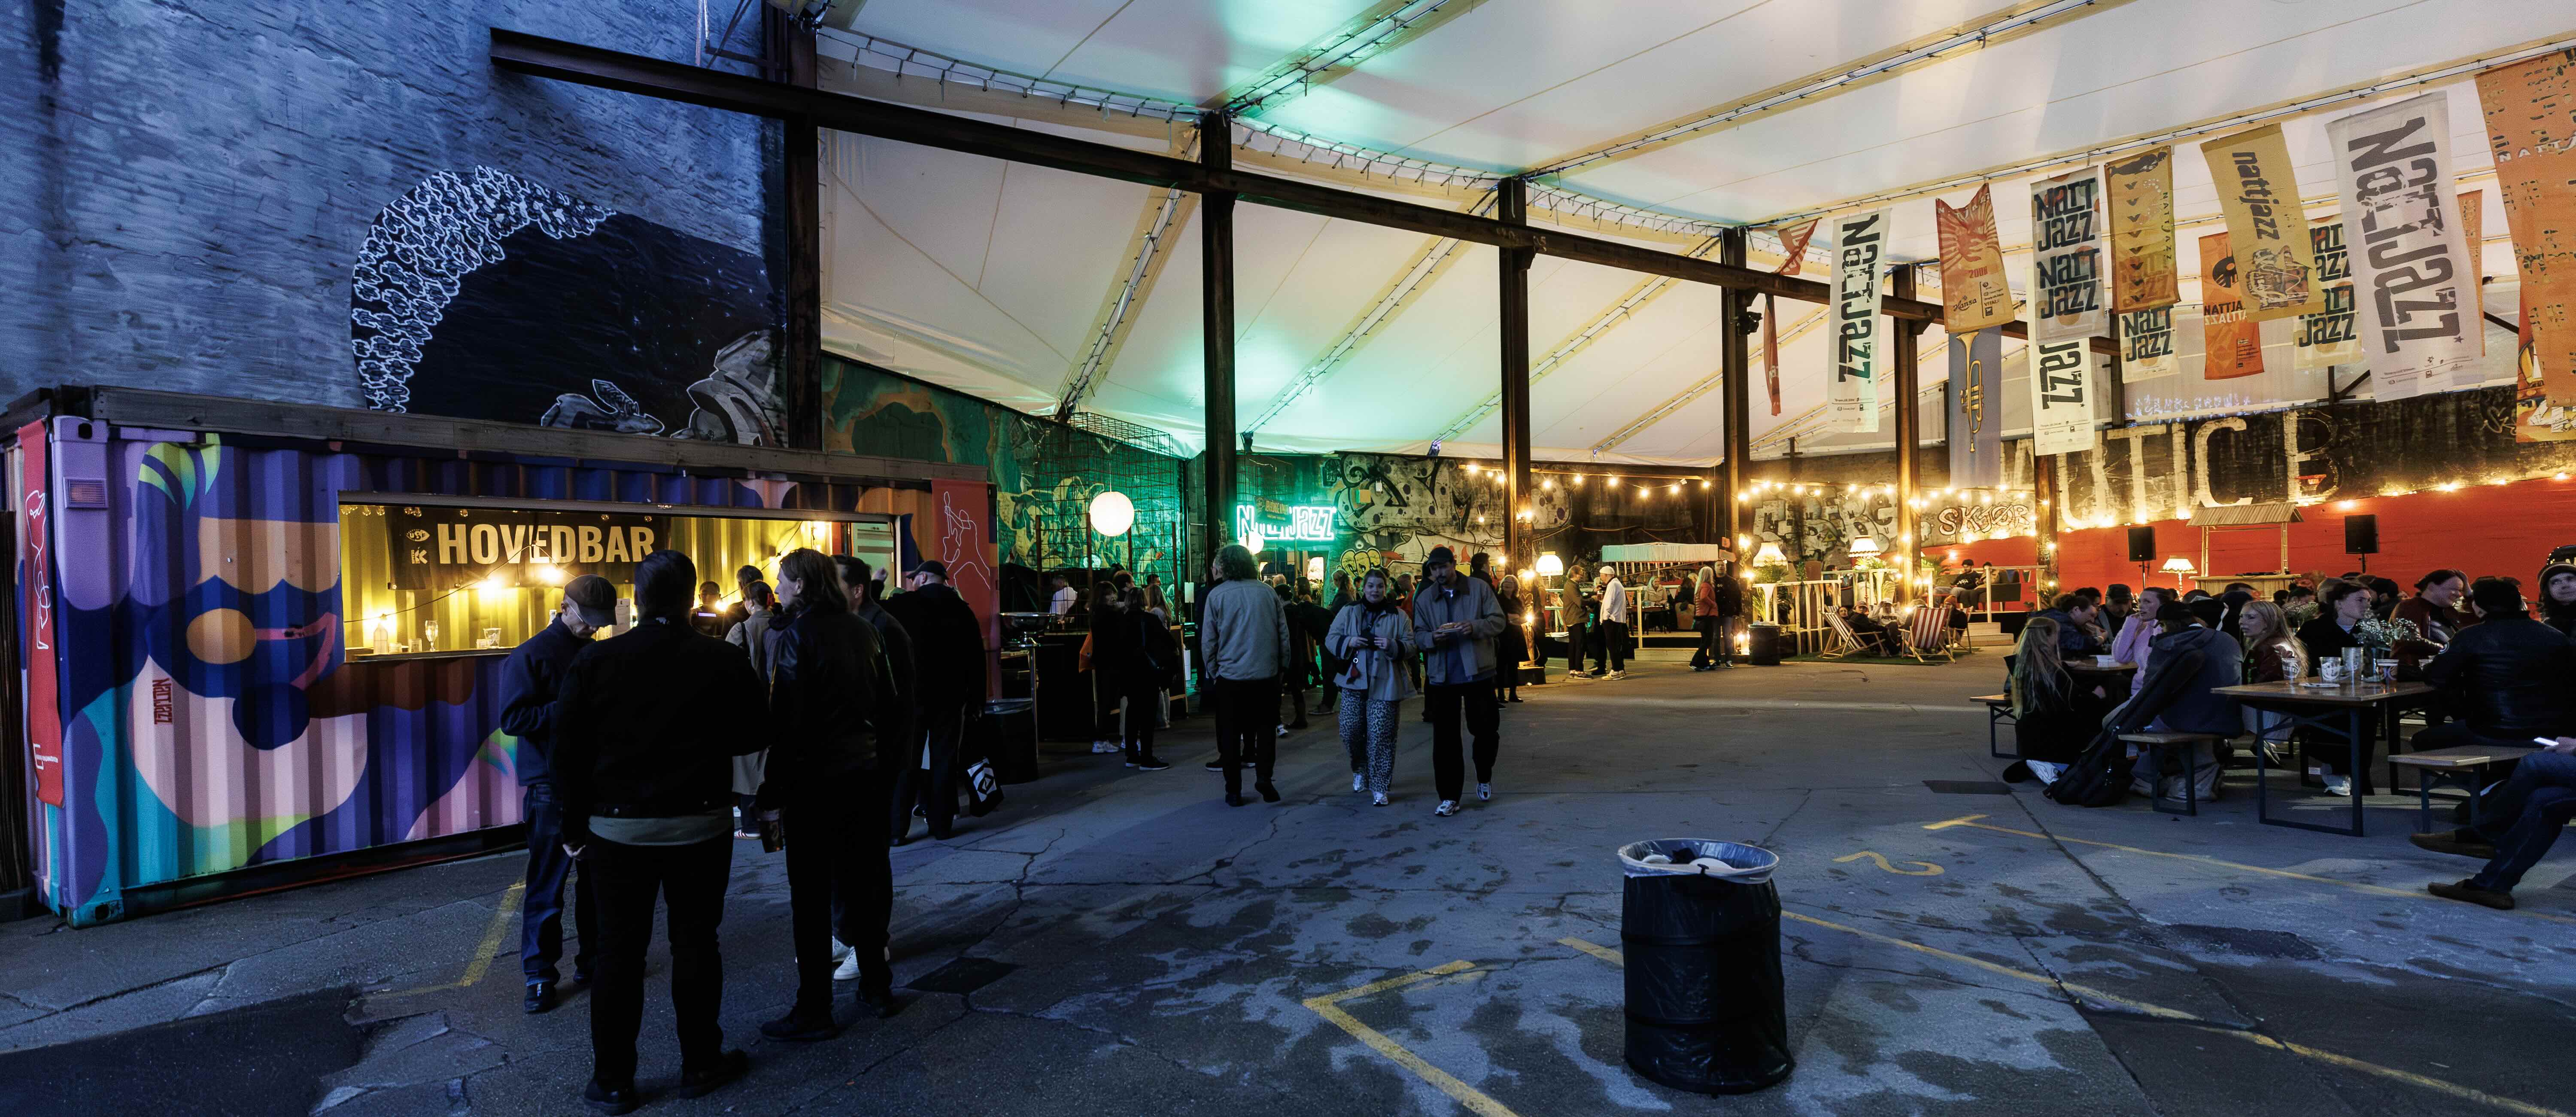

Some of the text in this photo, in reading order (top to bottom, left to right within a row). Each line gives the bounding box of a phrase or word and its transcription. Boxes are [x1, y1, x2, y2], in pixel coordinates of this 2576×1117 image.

[2233, 152, 2280, 240] nattjazz
[1953, 298, 1977, 311] Hansa
[2204, 300, 2246, 316] NATTJA
[437, 523, 655, 564] HOVEDBAR
